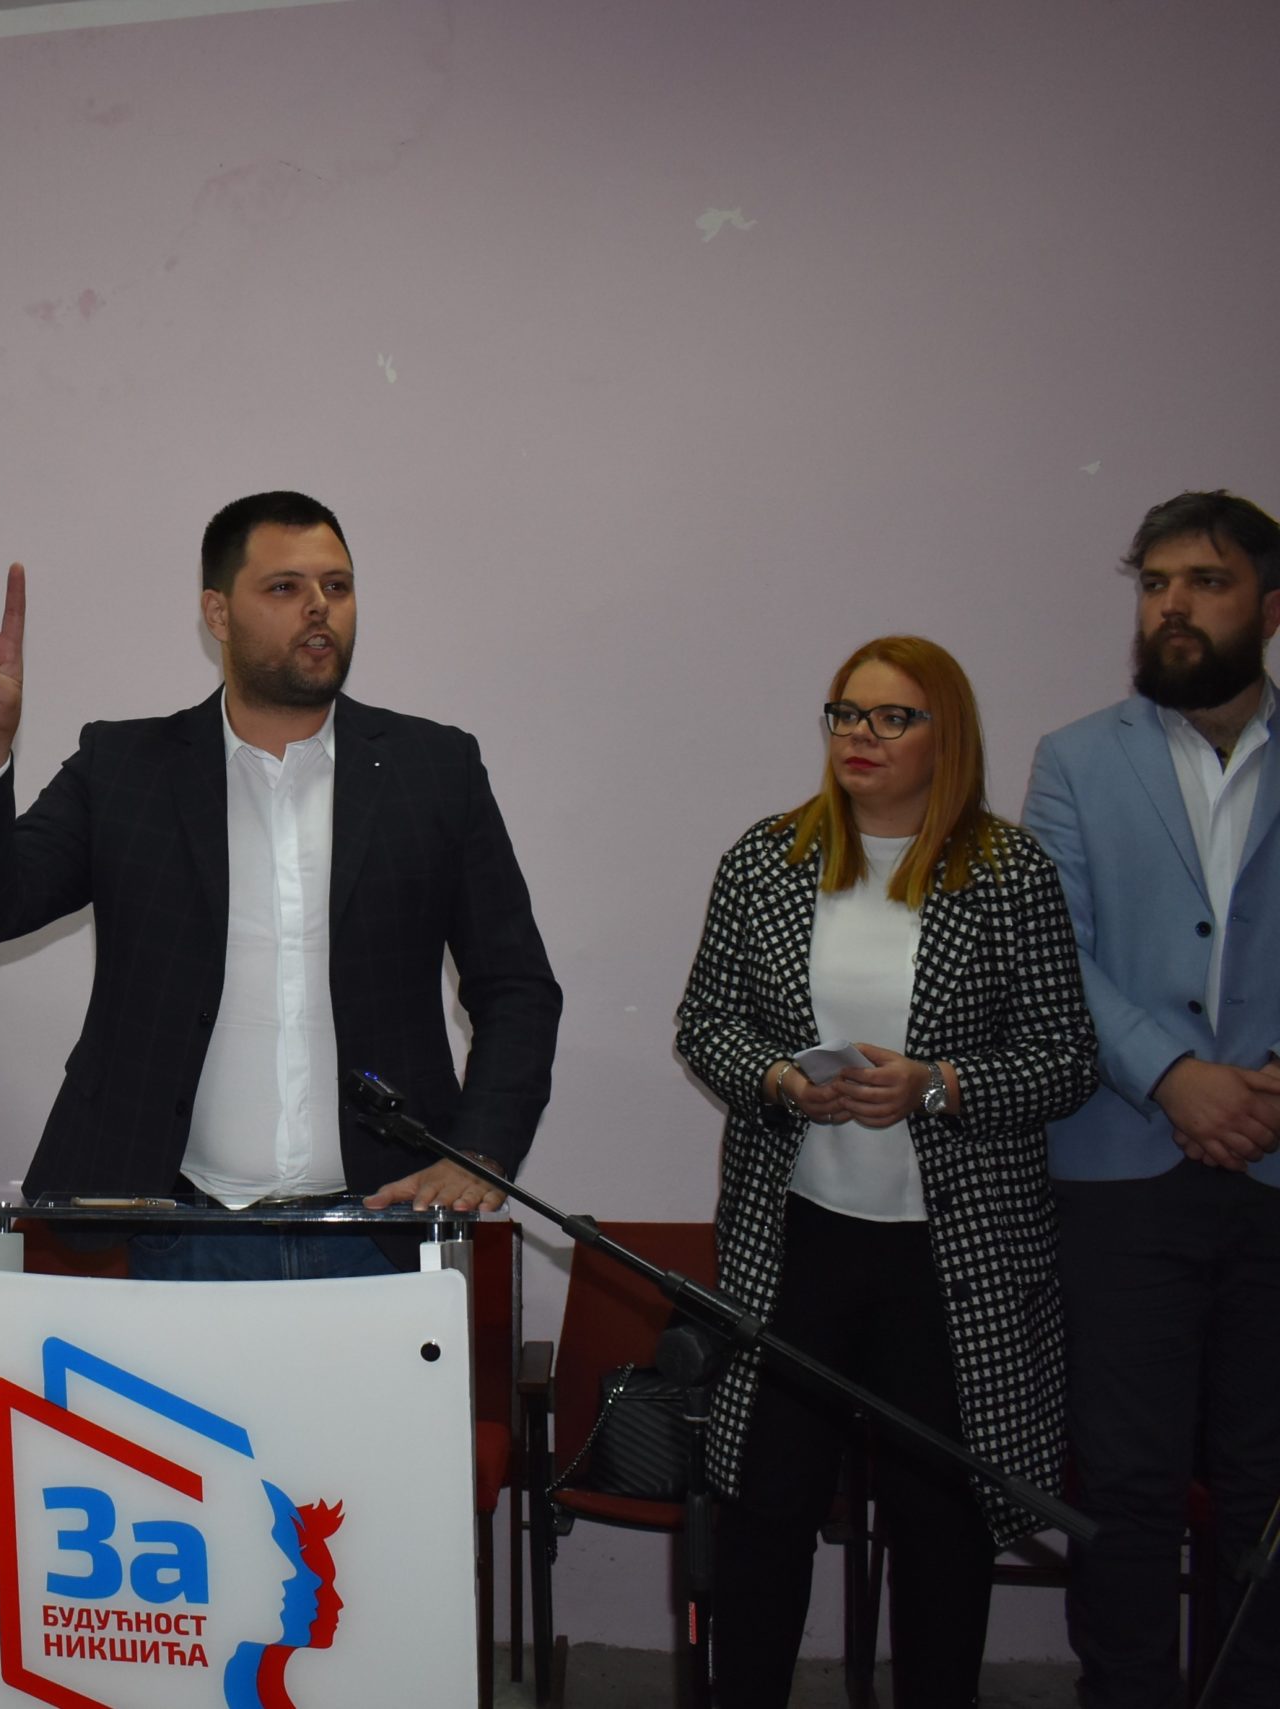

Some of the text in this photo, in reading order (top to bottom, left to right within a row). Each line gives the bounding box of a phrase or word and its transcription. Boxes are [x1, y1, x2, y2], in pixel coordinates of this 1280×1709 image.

[42, 1486, 209, 1604] За
[42, 1604, 208, 1637] БУДУЋНОСТ
[43, 1633, 209, 1668] НИКШИЋА
